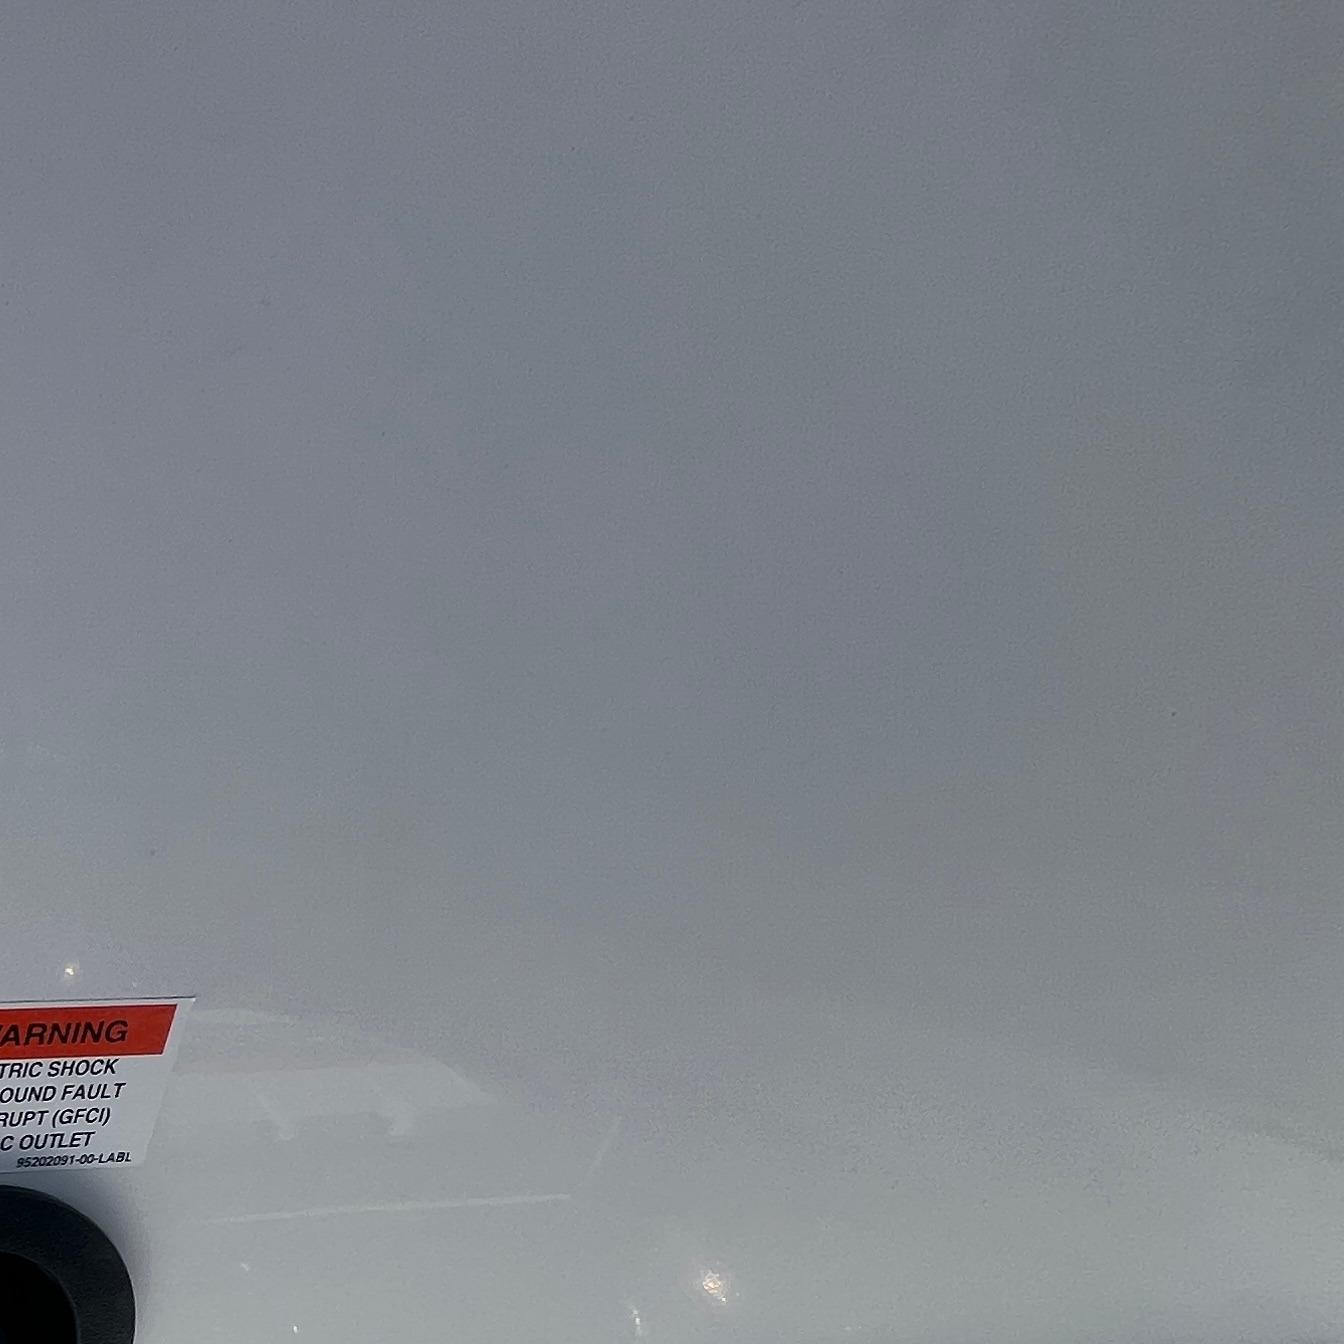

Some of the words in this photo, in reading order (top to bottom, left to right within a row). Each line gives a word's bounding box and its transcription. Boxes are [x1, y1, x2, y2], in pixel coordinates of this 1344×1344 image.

[48, 1059, 119, 1077] SHOCK
[60, 1082, 126, 1100] FAULT
[52, 1107, 111, 1128] (GFCI)
[19, 1132, 95, 1150] OUTLET
[16, 1152, 131, 1168] 95202091-00-LABL
